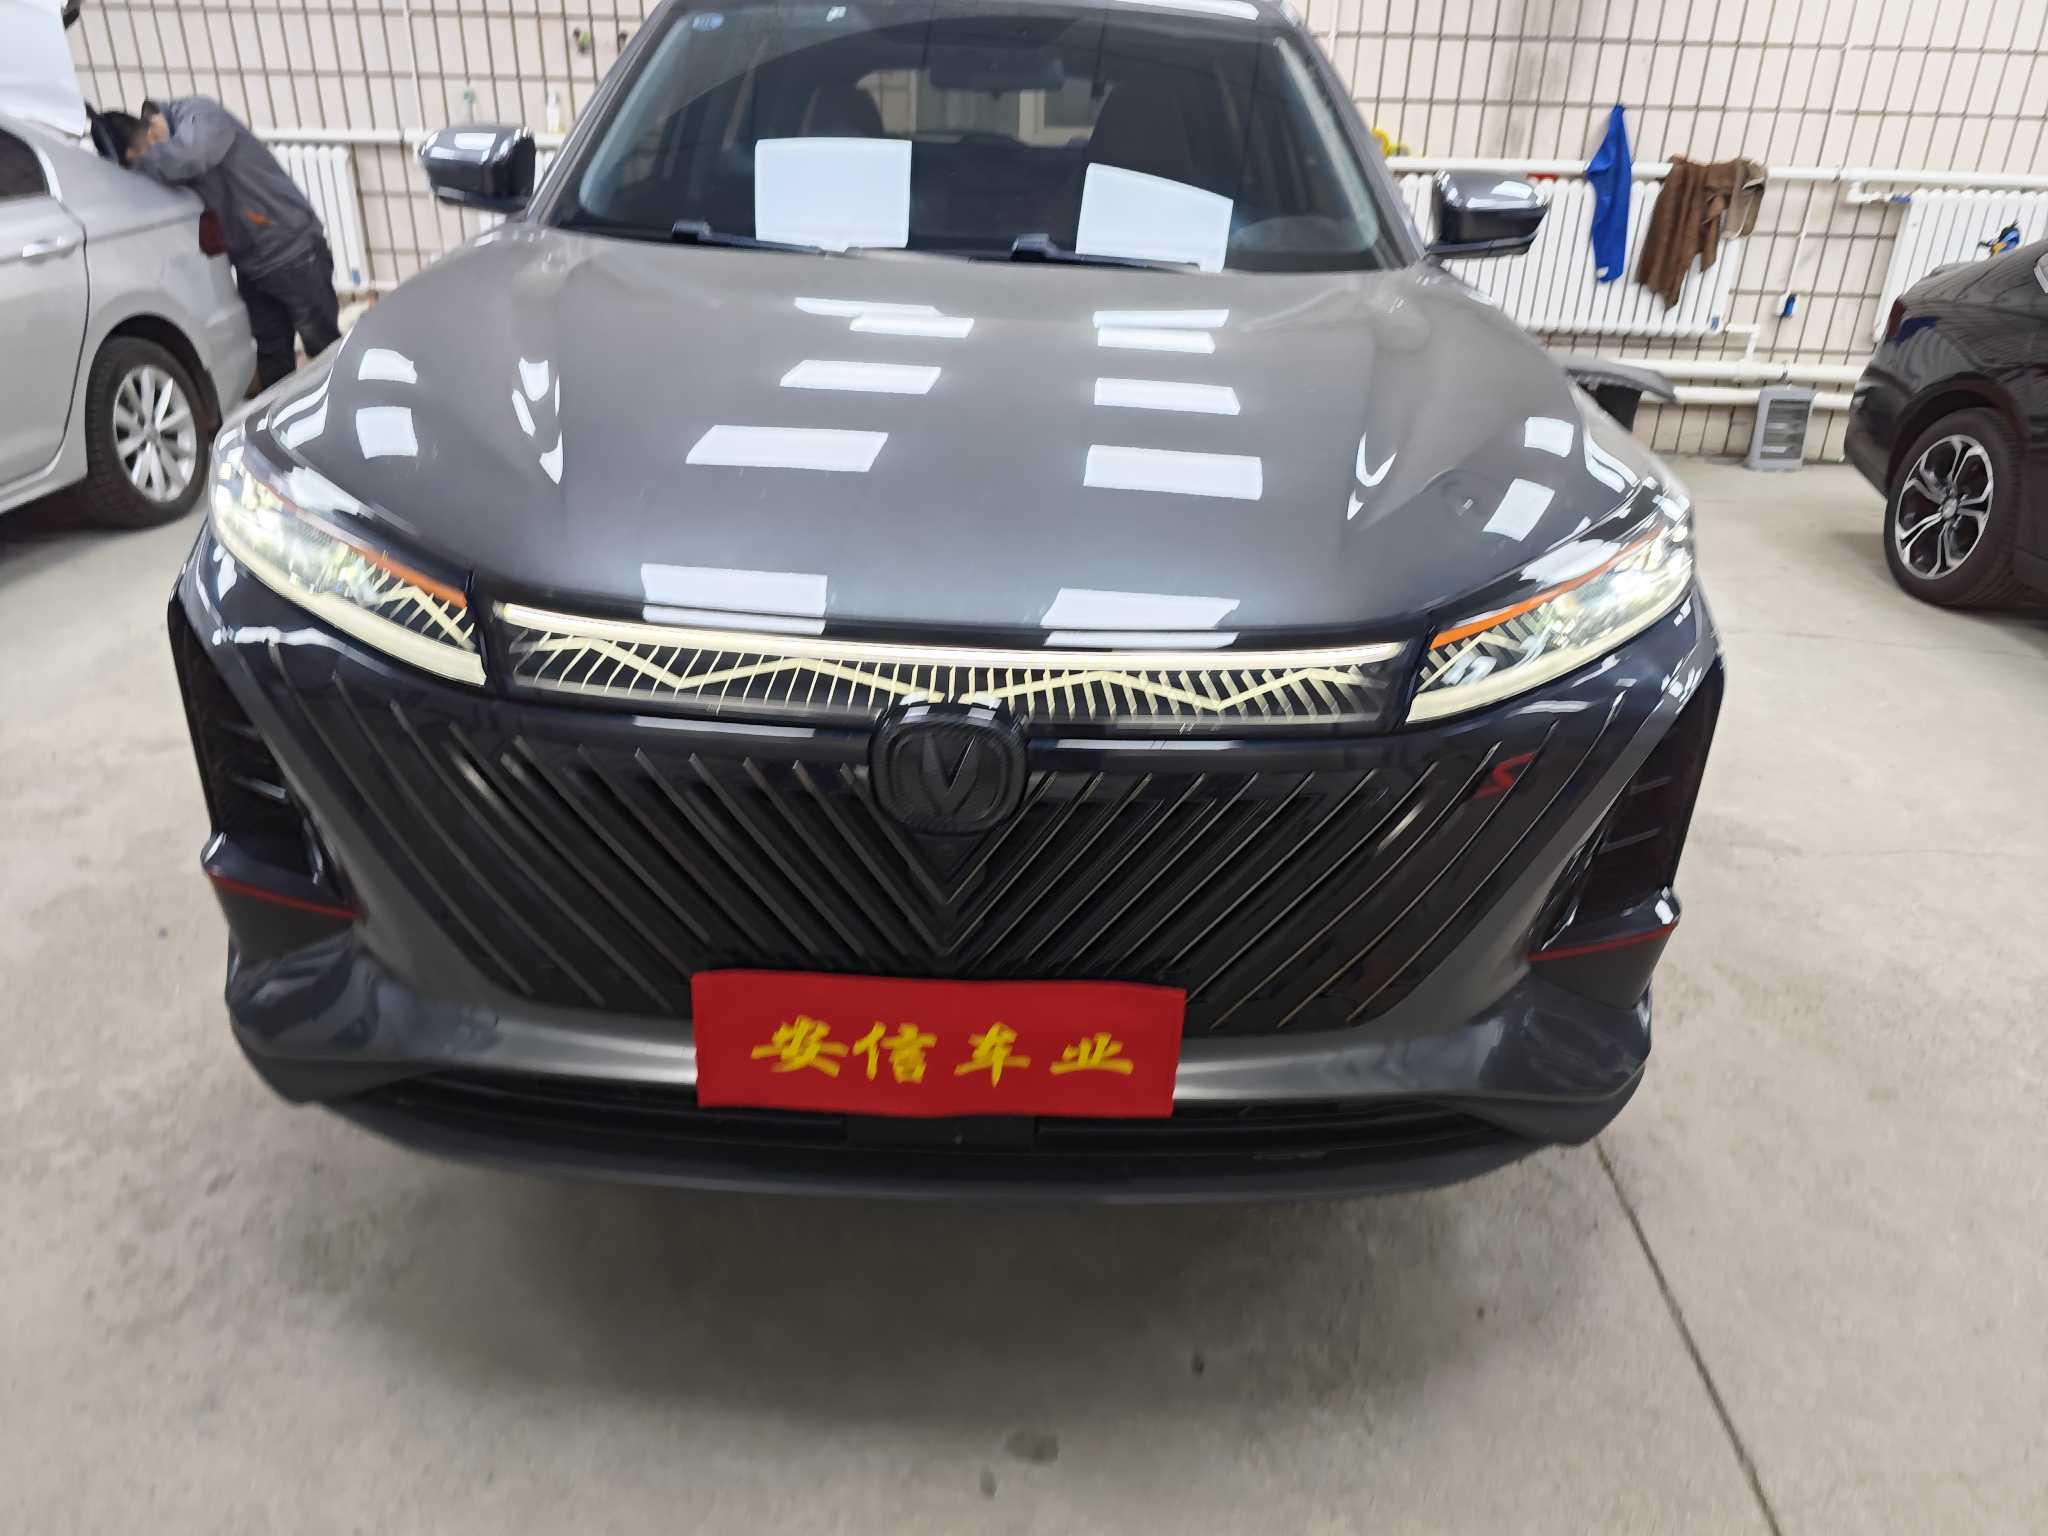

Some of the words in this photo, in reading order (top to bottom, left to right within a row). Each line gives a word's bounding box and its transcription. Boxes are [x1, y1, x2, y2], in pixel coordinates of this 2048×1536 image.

[1472, 751, 1534, 800] S
[750, 1014, 1134, 1088] 安信车业
